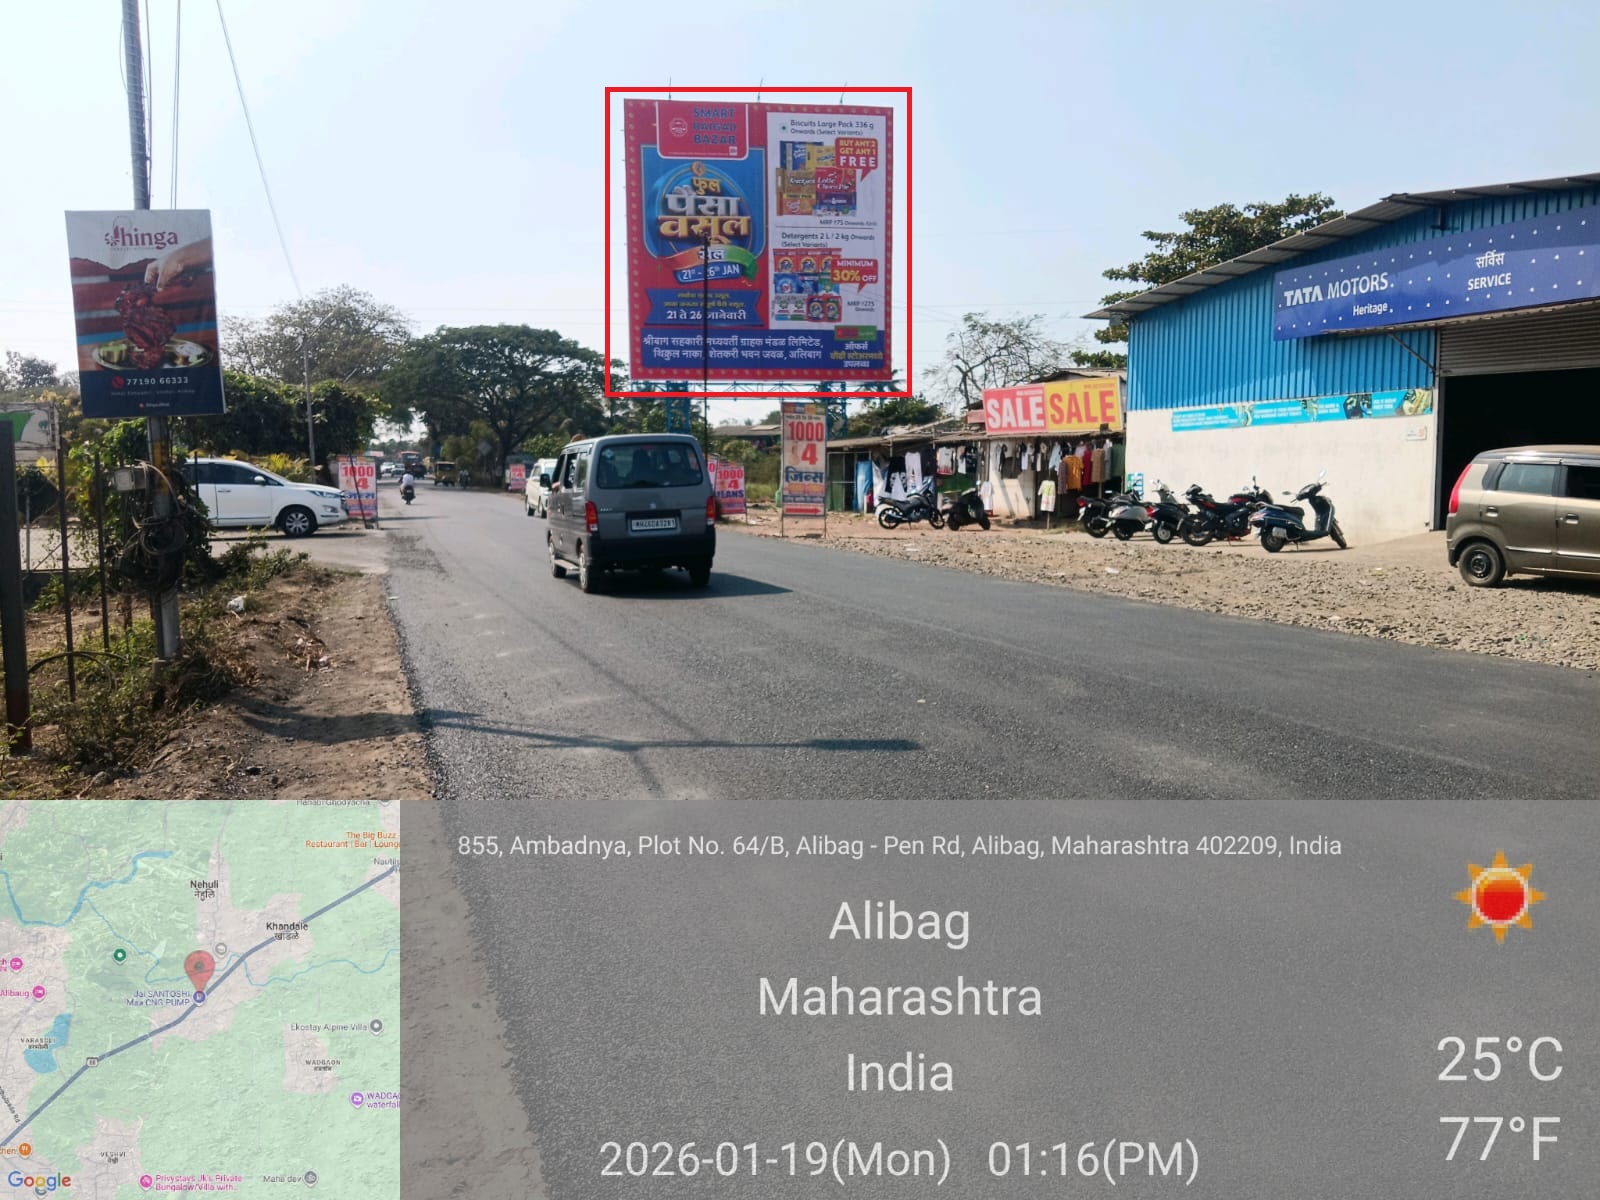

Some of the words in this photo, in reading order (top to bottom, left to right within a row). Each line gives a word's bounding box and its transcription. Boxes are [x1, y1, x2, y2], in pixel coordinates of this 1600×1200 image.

[692, 107, 736, 118] SMART
[790, 120, 816, 129] Biscuits
[817, 120, 836, 130] Large
[838, 121, 853, 129] Pack
[693, 134, 737, 145] BAZAR
[839, 155, 877, 167] FREE
[692, 177, 721, 196] फुल
[664, 186, 741, 216] पैसा
[657, 216, 751, 246] वसूल
[781, 232, 819, 241] Detergents
[841, 233, 849, 241] kg
[1475, 249, 1505, 269] सर्विस
[722, 263, 740, 276] JAN
[833, 269, 860, 281] 30%
[1467, 272, 1512, 291] SERVICE
[1283, 285, 1323, 307] TATA
[1327, 272, 1389, 300] MOTORS
[666, 310, 677, 320] 21
[679, 308, 687, 320] ते
[689, 310, 703, 320] 26
[706, 308, 747, 320] जानेवारी
[1352, 302, 1388, 316] Heritage
[643, 334, 668, 348] श्रीबाग
[670, 334, 704, 347] सहकारी
[765, 336, 786, 347] मंडळ
[788, 335, 824, 348] लिमिटेड,
[708, 347, 739, 360] शेतकरी
[741, 349, 761, 360] भवन
[788, 347, 823, 360] अलिबाग
[986, 395, 1045, 429] SALE
[1049, 390, 1116, 424] SALE
[788, 421, 825, 442] 1000
[801, 443, 818, 465] 4
[343, 466, 374, 477] 1000
[718, 469, 744, 479] 1000
[357, 478, 369, 489] 4
[728, 480, 740, 490] 4
